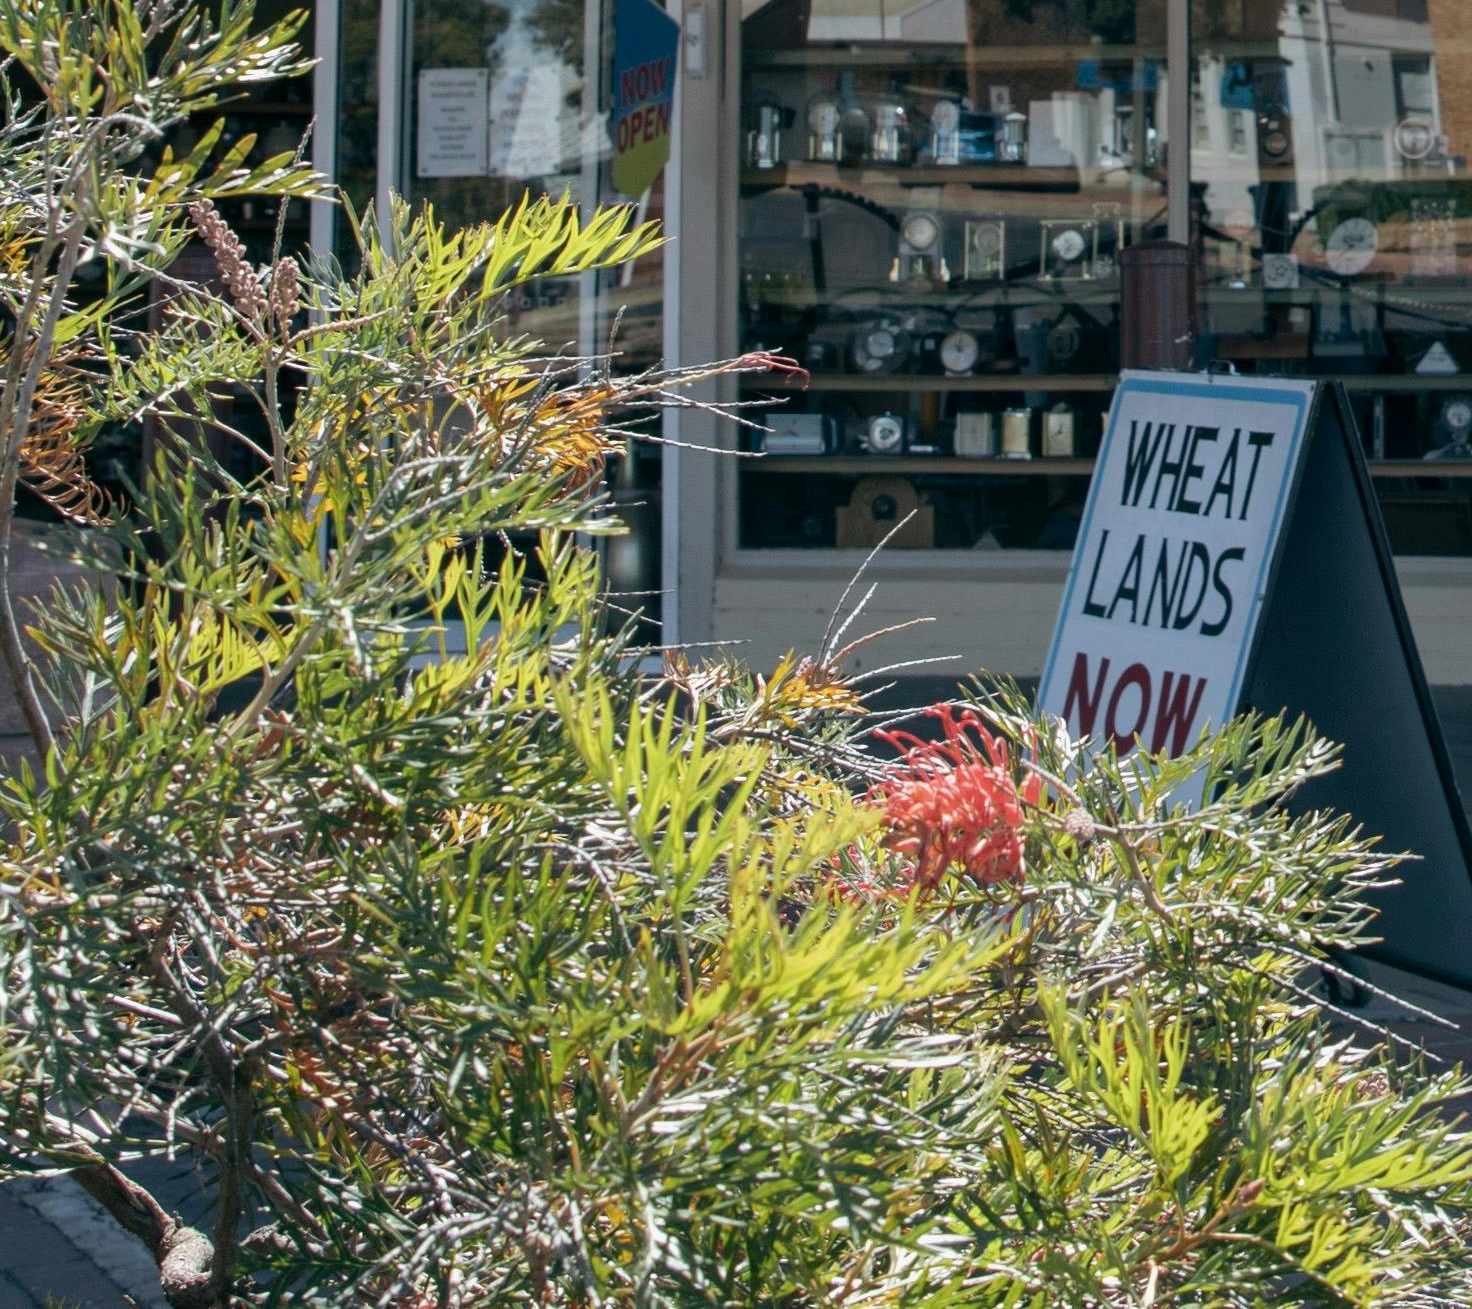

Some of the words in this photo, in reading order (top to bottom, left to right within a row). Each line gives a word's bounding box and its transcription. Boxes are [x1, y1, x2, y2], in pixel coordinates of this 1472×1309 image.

[617, 100, 672, 154] OPEN
[620, 54, 672, 107] NOW
[1120, 419, 1276, 521] WHEAT
[1081, 529, 1247, 637] LANDS
[1063, 651, 1208, 762] NOW
